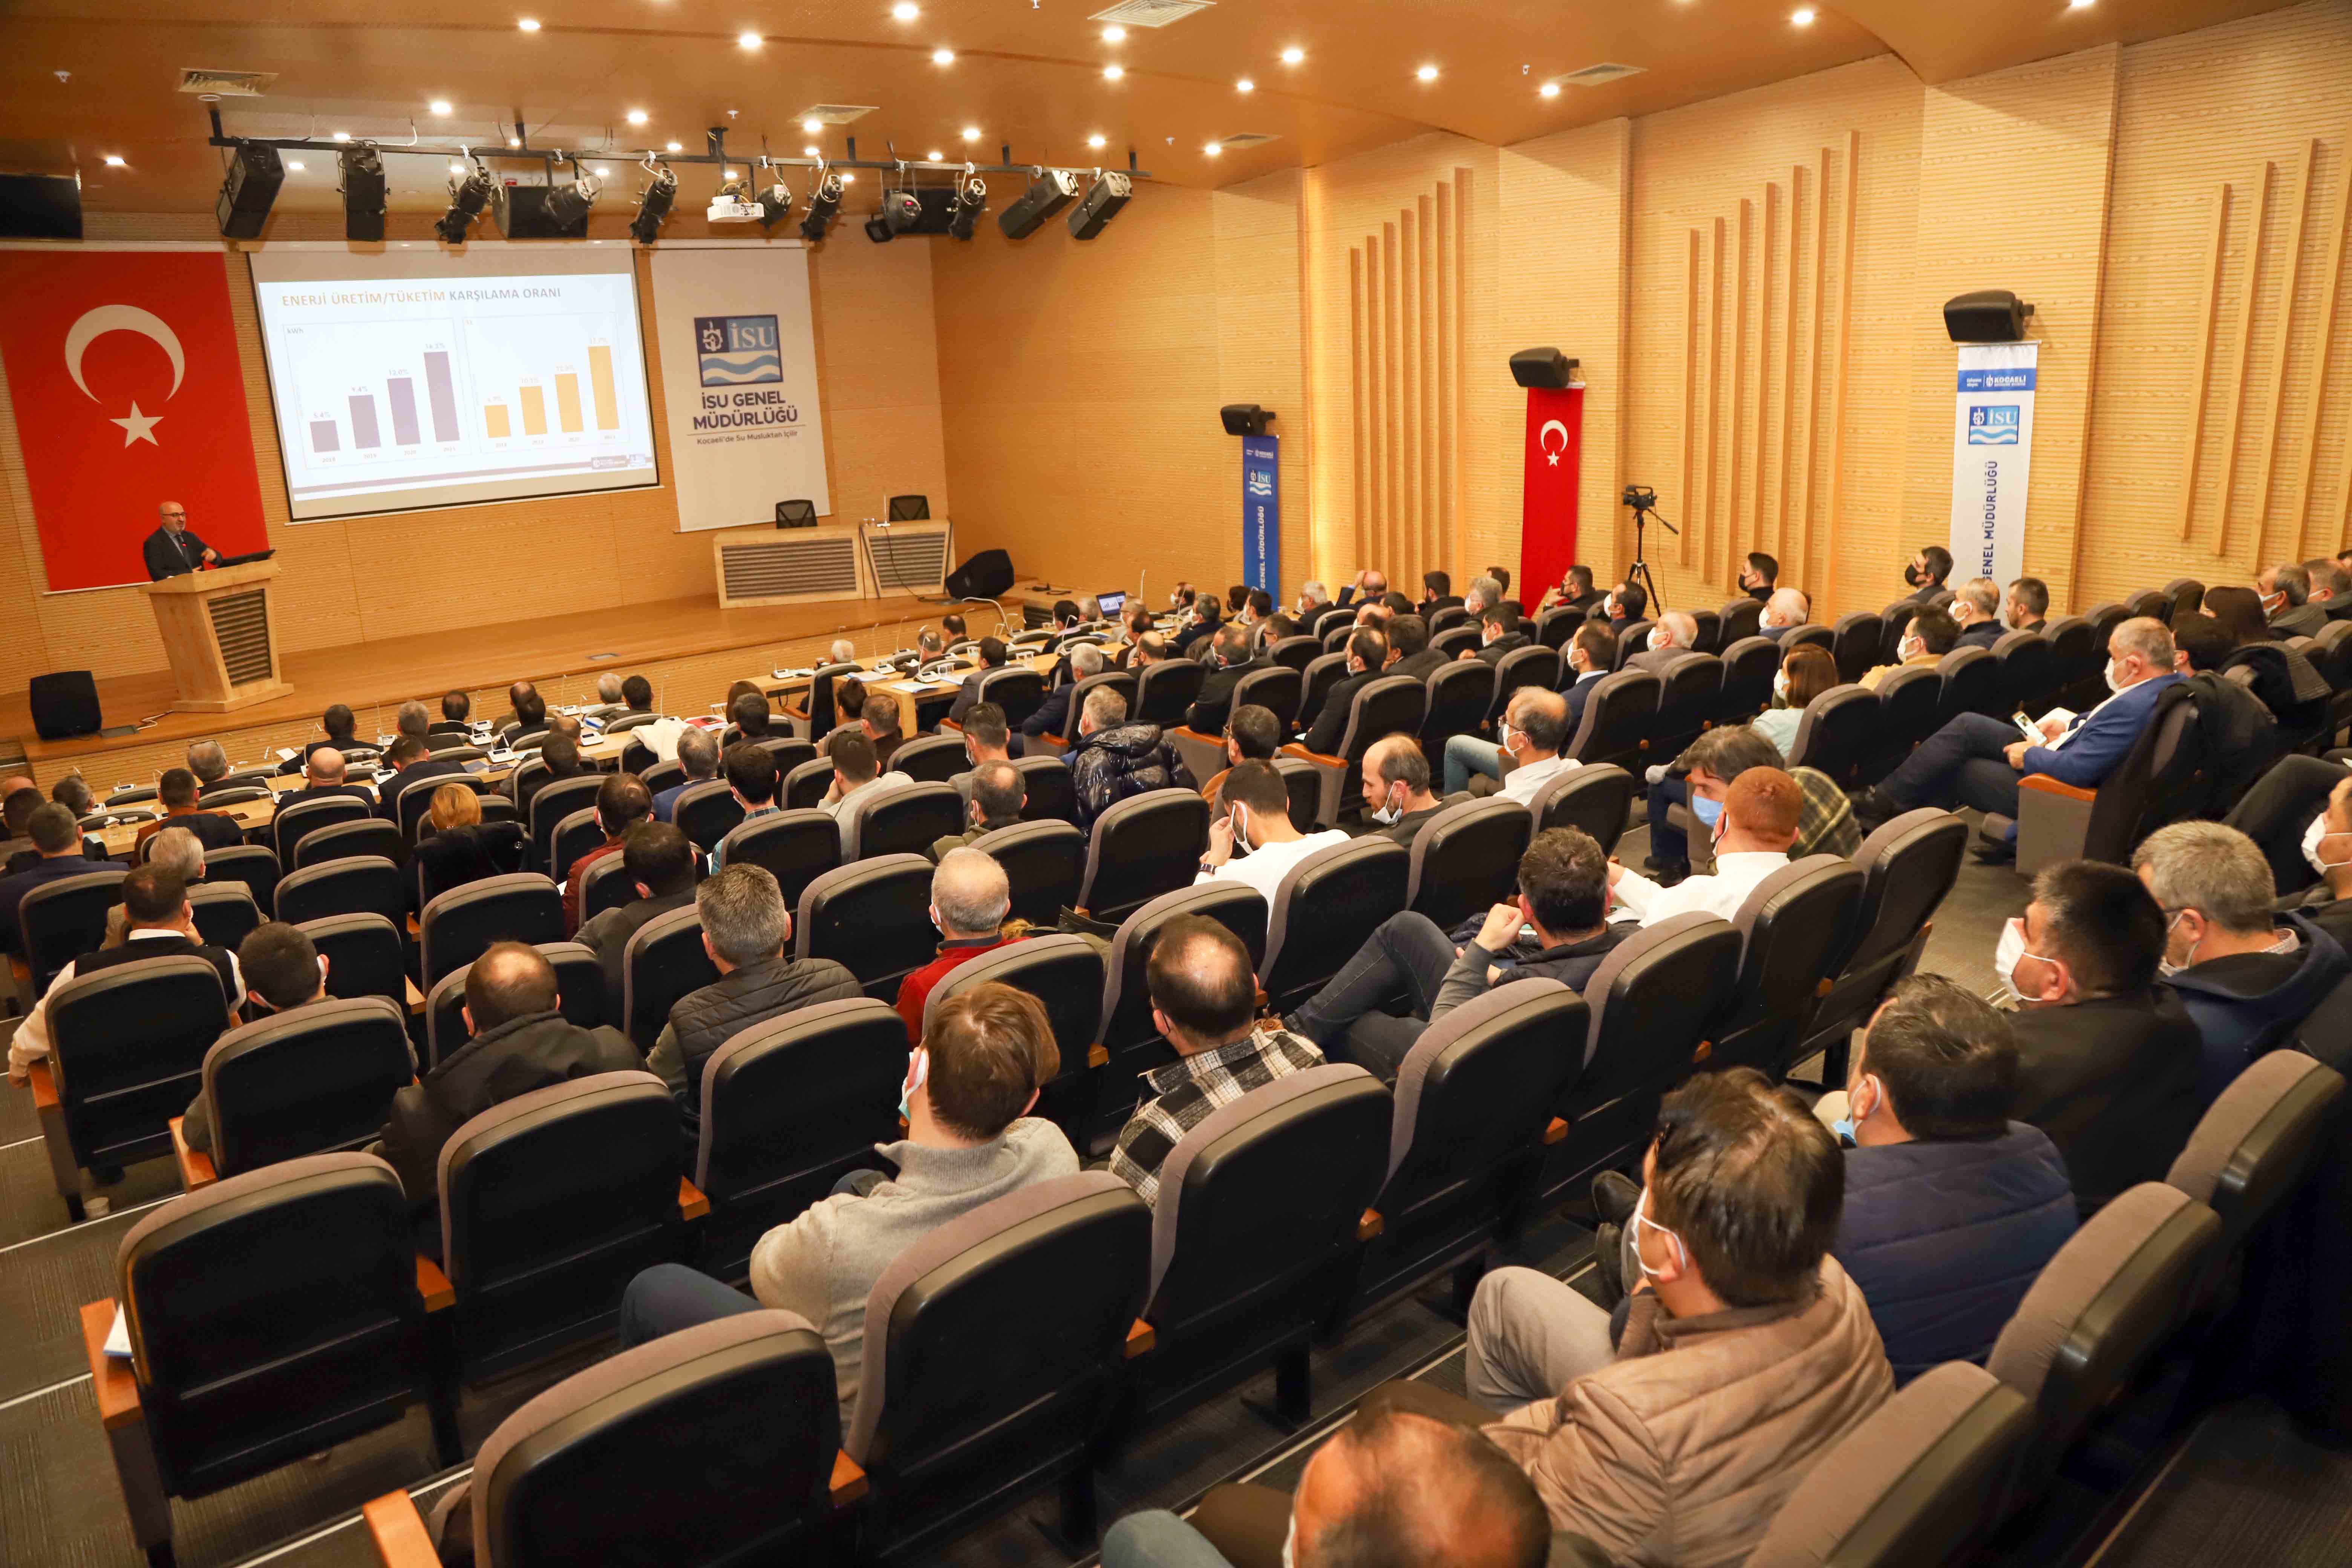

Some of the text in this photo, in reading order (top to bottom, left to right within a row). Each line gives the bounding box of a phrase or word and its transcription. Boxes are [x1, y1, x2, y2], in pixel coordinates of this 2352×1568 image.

[283, 288, 561, 306] ENERJİ ÜRETİM/TÜKETİM KARŞILAMA ORANI
[730, 323, 775, 349] İSU
[701, 390, 786, 409] İSU GENEL
[693, 406, 798, 430] MÜDÜRLÜĞÜ
[1989, 408, 2017, 424] İSU
[1981, 461, 1998, 539] MÜDÜRLÜĞÜ
